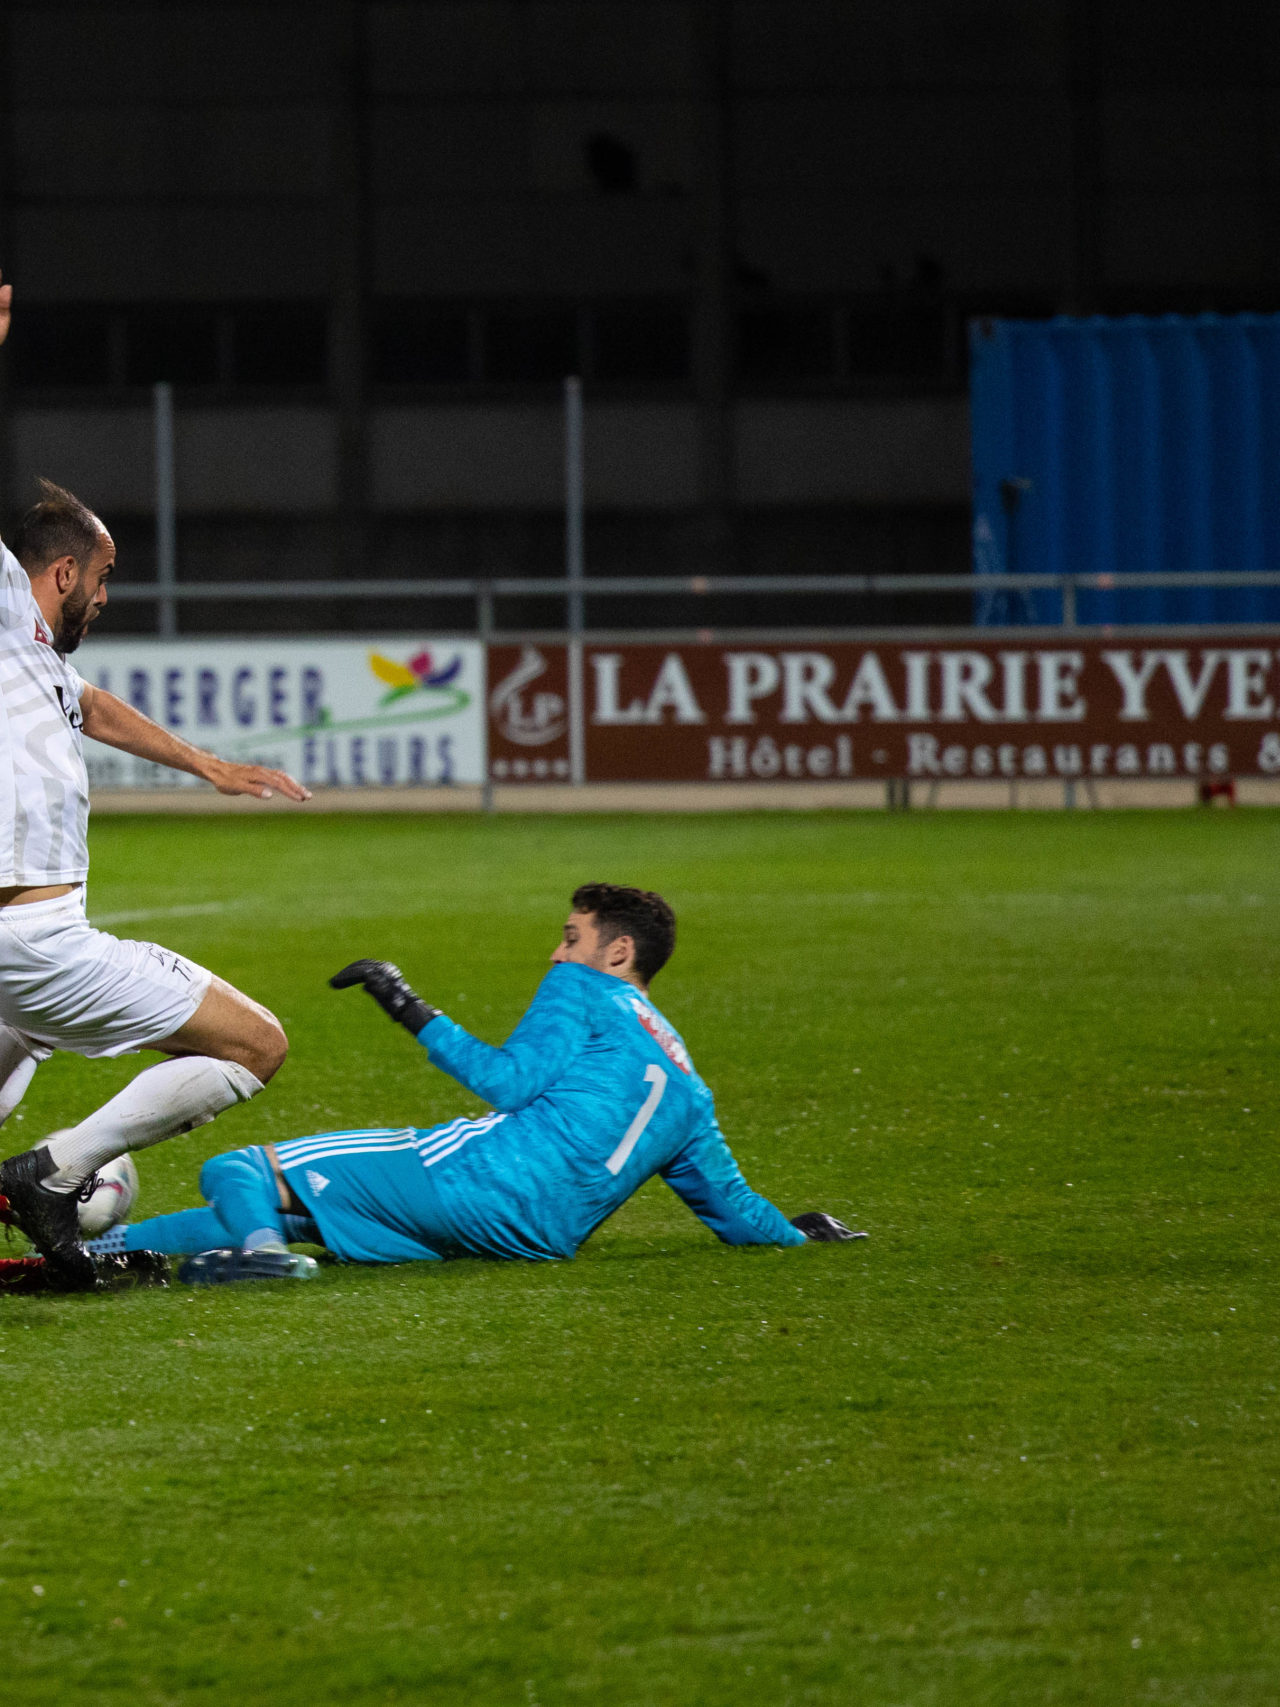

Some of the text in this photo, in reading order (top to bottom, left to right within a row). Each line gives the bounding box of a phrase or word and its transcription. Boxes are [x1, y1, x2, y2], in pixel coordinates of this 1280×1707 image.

[591, 649, 1280, 726] LA PRAIRIE YVE
[303, 737, 454, 787] FLEURS
[707, 733, 853, 777] Hôtel
[906, 733, 1230, 776] Restaurants
[604, 1063, 668, 1176] 1
